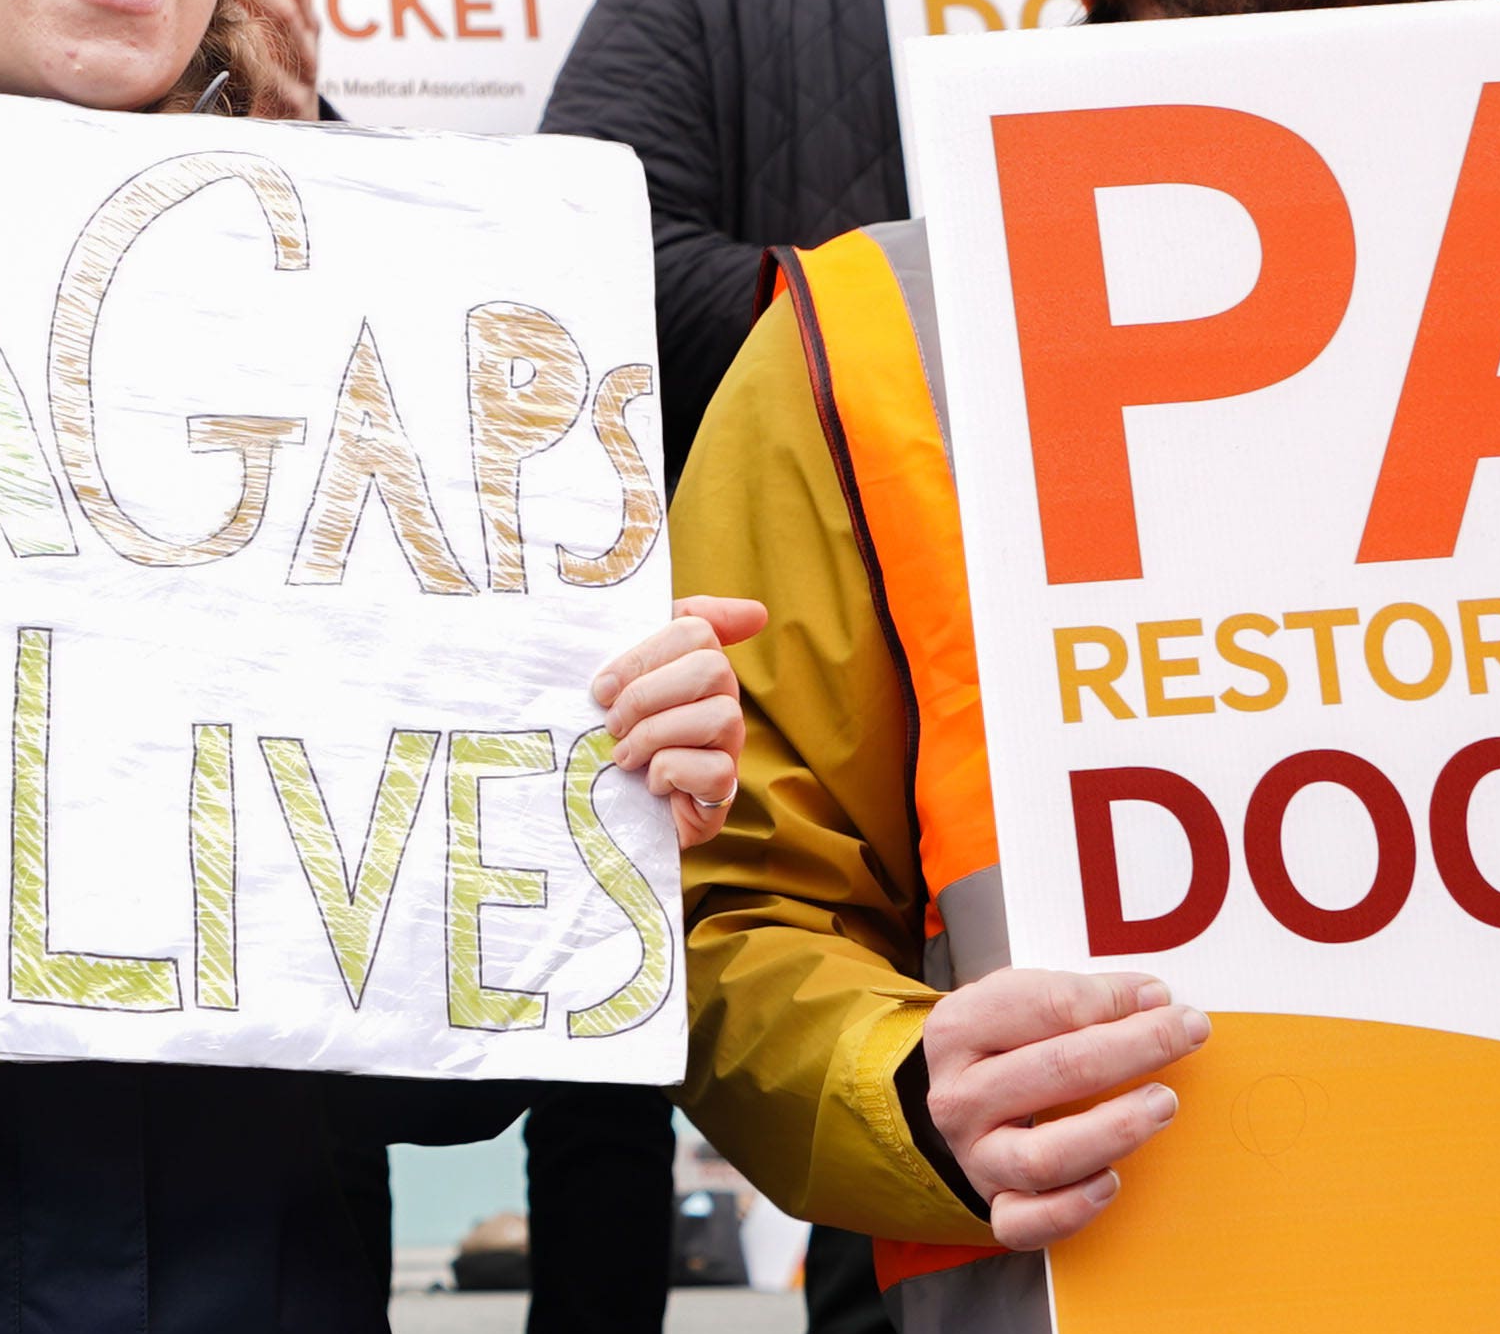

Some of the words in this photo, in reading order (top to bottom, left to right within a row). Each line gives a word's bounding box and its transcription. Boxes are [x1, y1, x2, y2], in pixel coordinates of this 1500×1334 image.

[343, 78, 414, 97] Medical
[419, 78, 525, 97] Association
[7, 625, 674, 1039] LIVES
